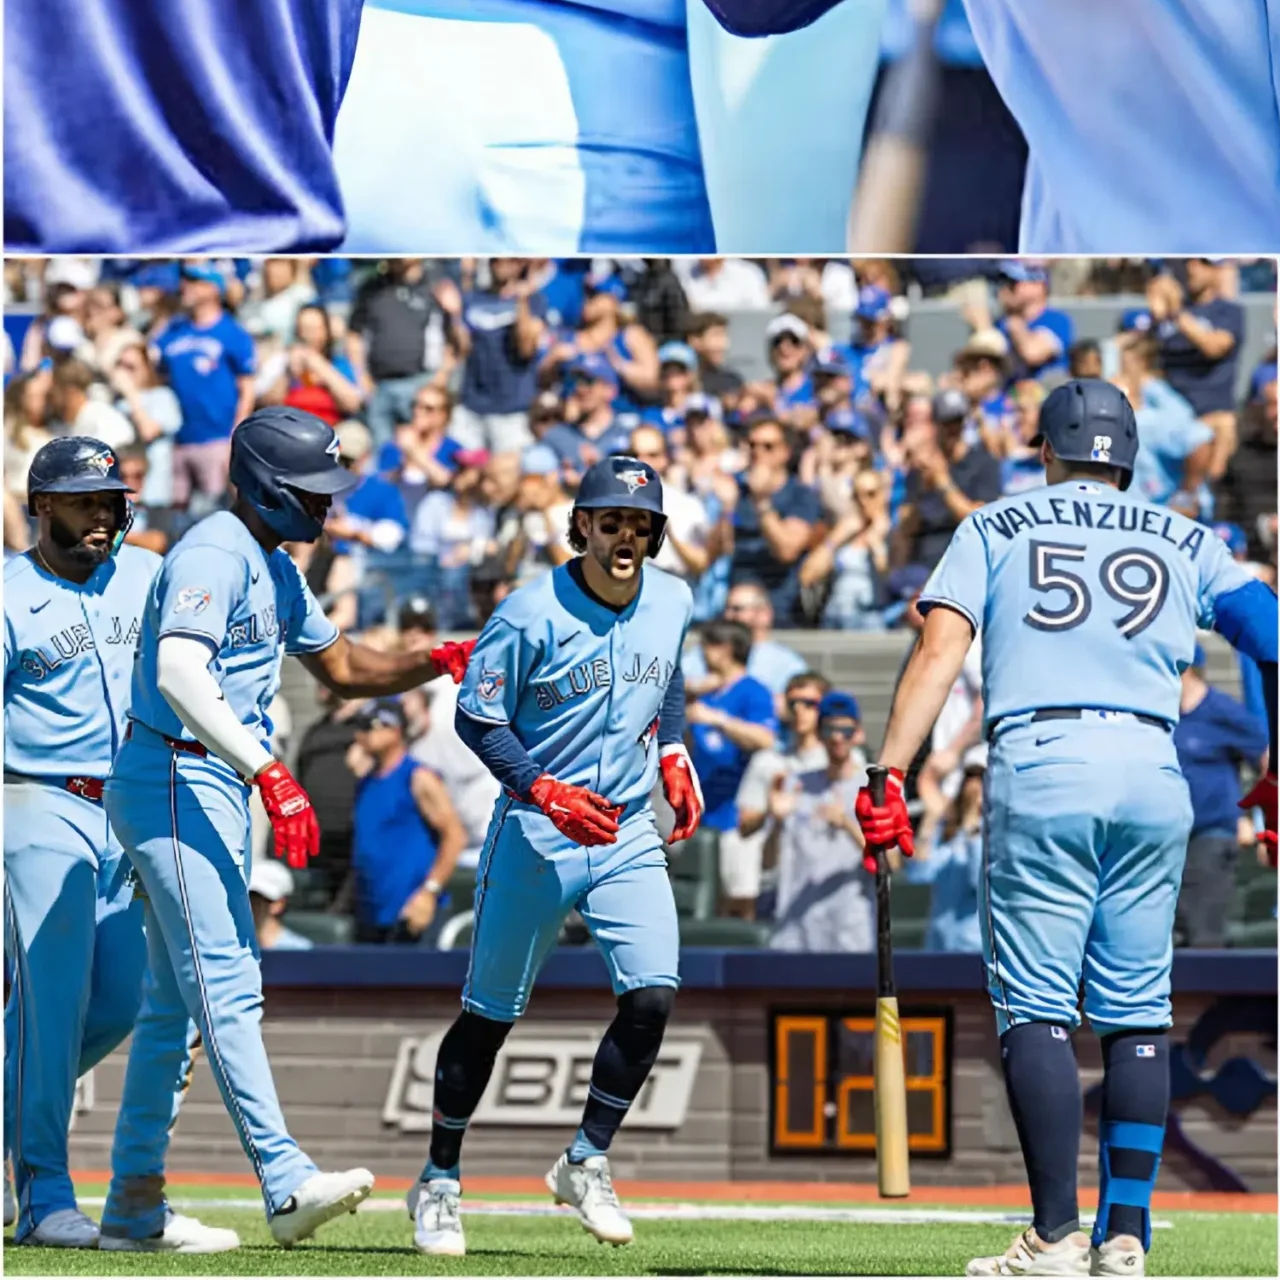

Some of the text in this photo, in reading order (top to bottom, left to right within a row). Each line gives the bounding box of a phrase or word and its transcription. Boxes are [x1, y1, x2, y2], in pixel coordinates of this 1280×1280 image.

[984, 497, 1205, 561] VALENZUELA
[1022, 538, 1170, 640] 59
[535, 658, 611, 711] BLUE
